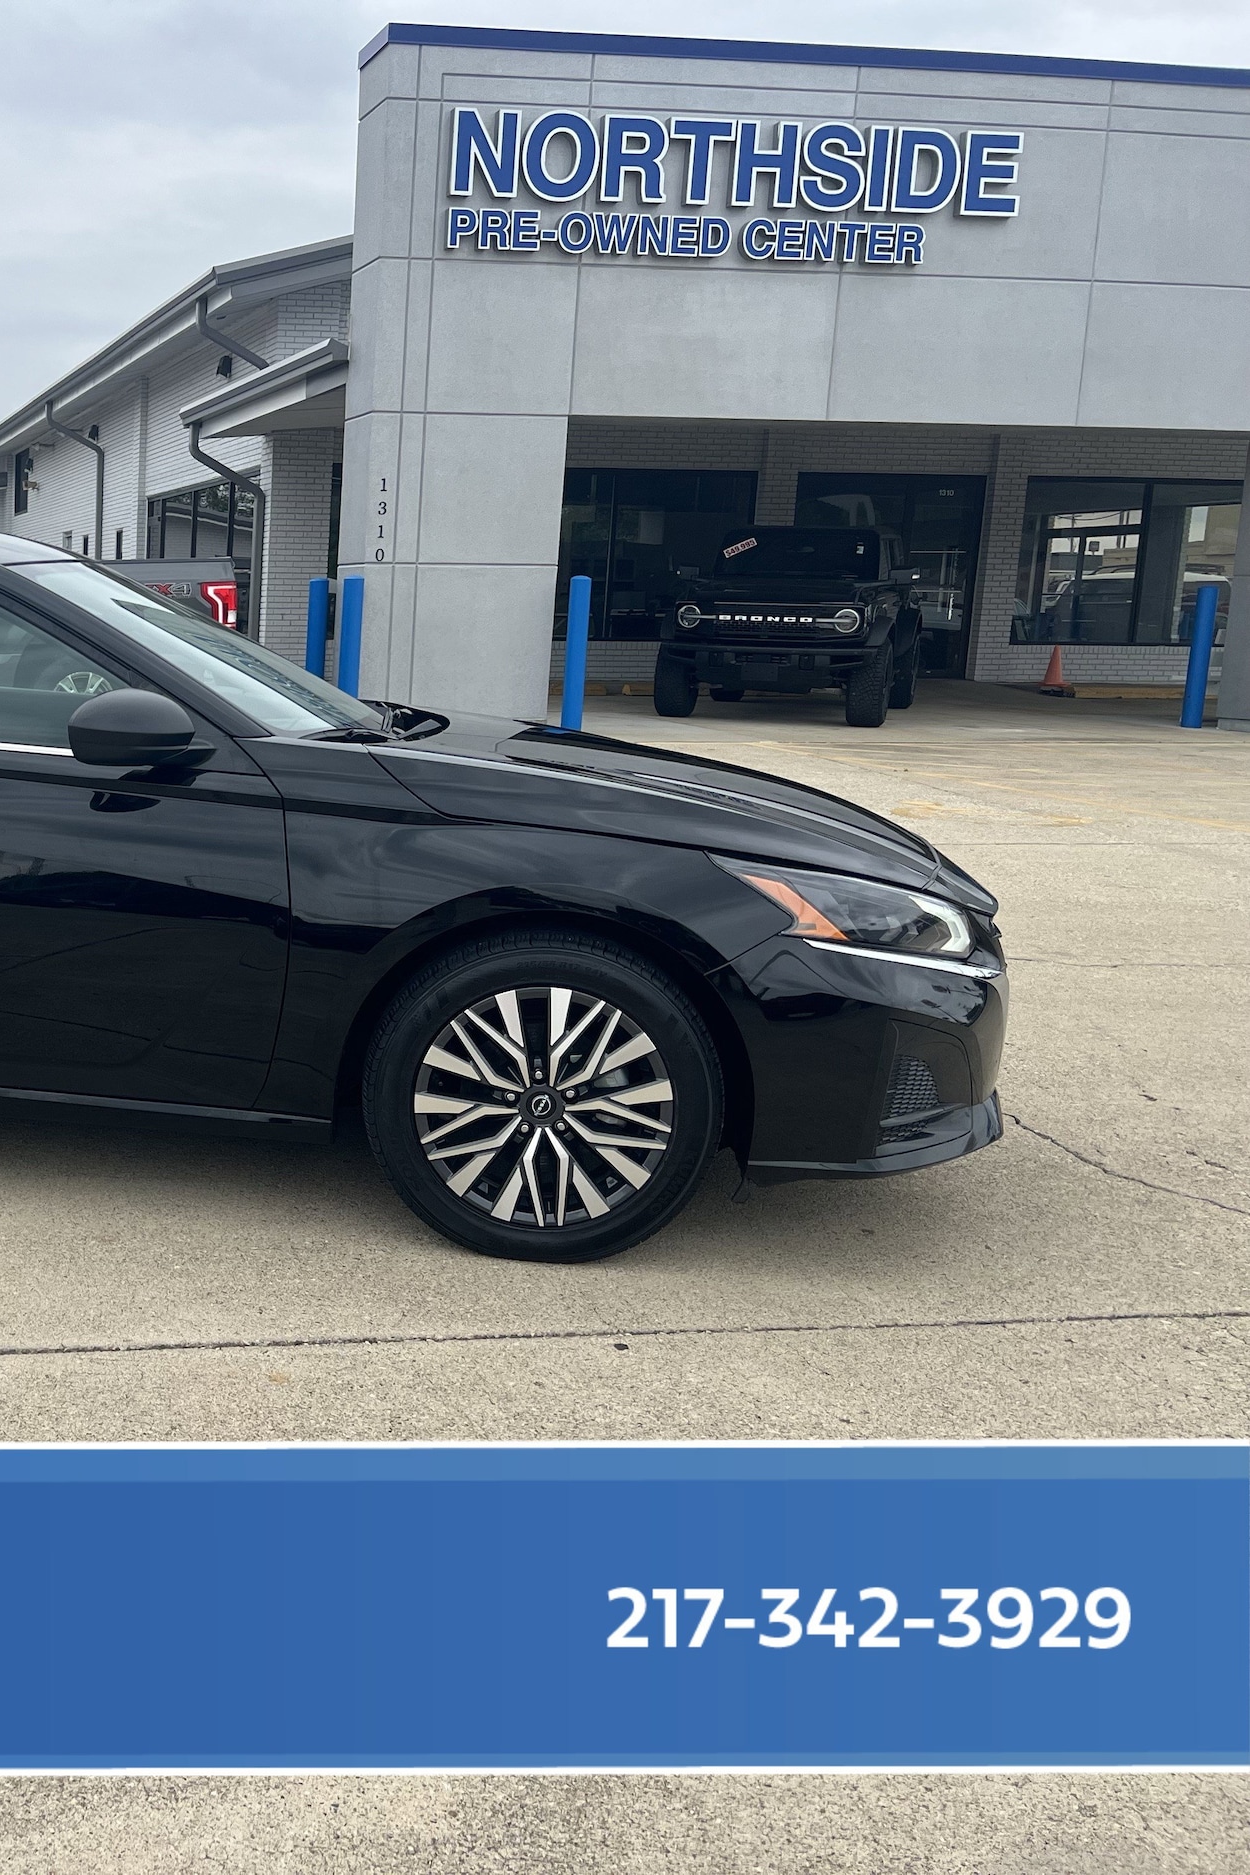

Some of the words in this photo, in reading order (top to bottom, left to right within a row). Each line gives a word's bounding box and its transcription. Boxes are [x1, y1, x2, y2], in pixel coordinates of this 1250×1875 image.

[449, 107, 1025, 217] NORTHSIDE
[446, 207, 732, 257] PRE-OWNED
[743, 217, 926, 265] CENTER
[374, 477, 388, 562] 1310
[939, 489, 955, 497] 1310
[718, 614, 813, 623] BRONCO
